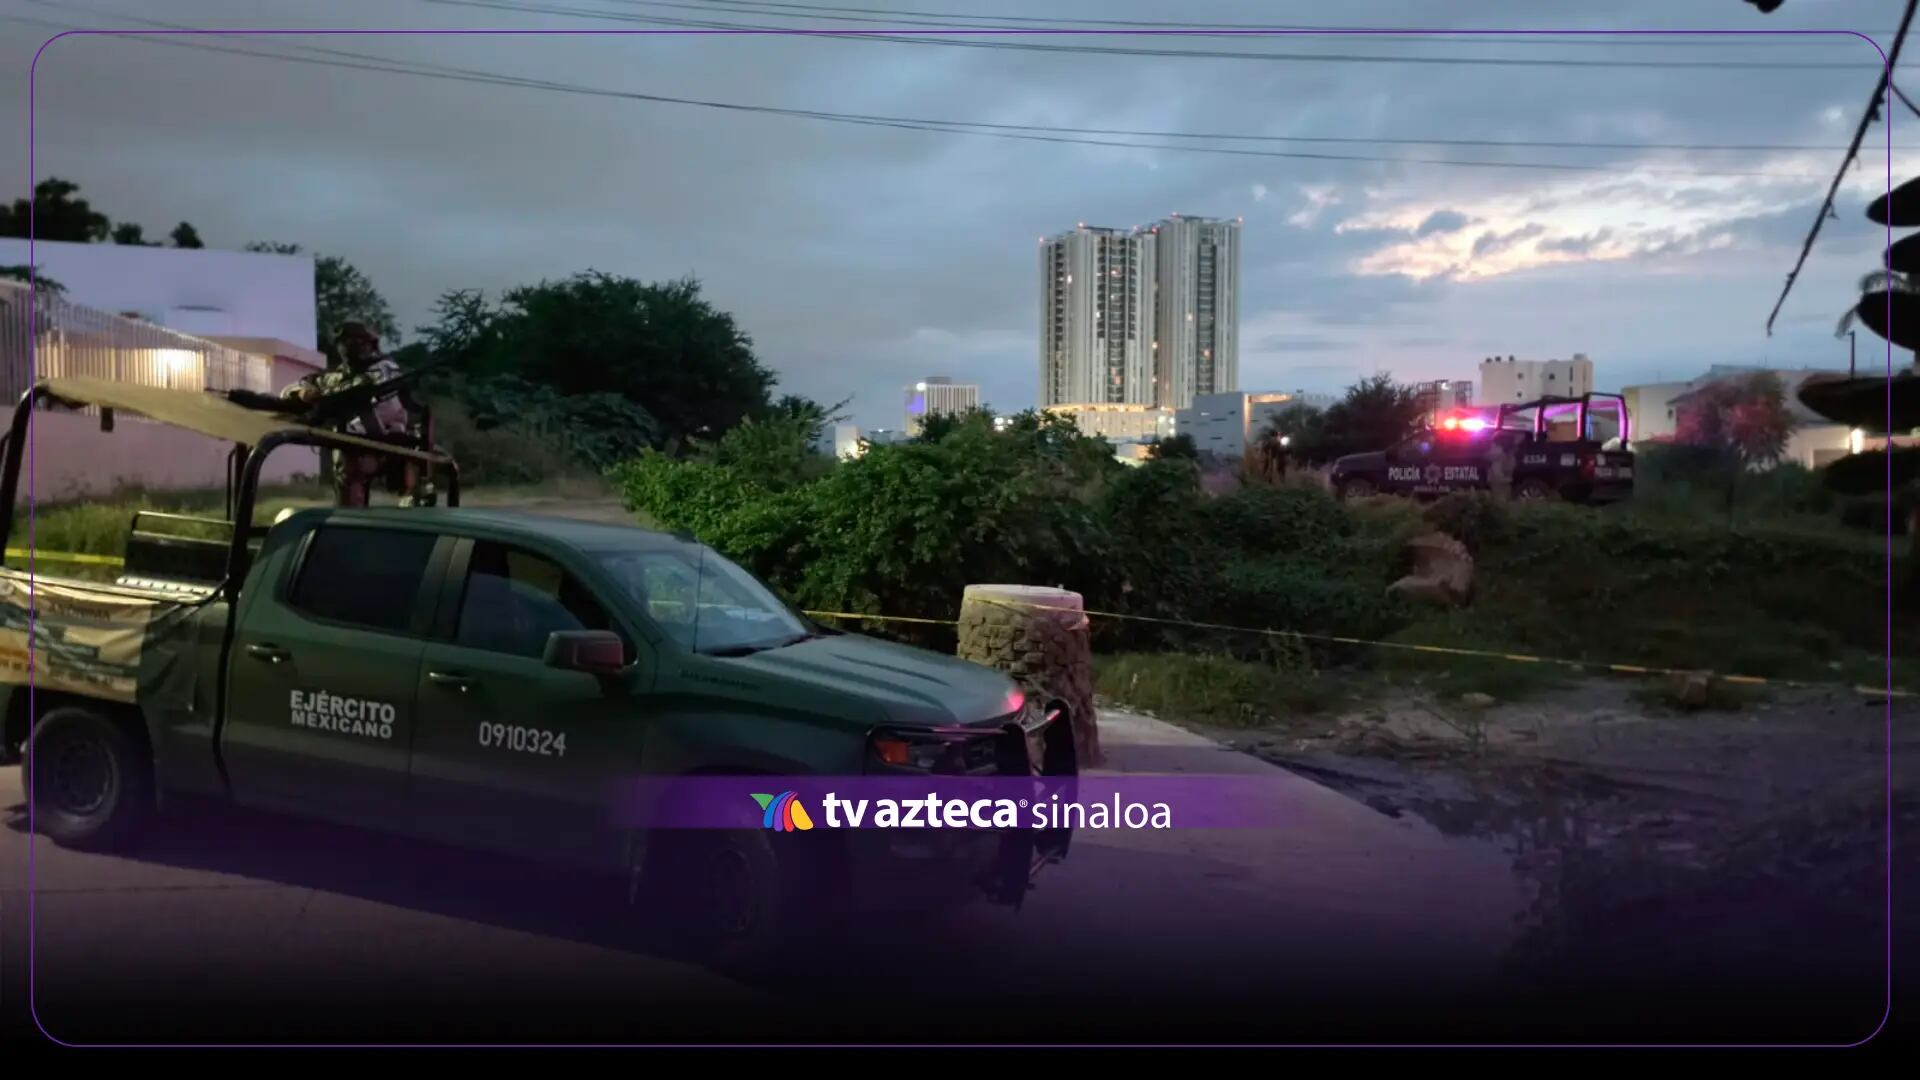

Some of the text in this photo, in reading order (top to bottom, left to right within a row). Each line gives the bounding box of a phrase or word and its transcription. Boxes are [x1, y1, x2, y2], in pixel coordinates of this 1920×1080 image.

[1444, 466, 1480, 481] ESTATAL
[290, 690, 395, 724] EJÉRCITO
[291, 710, 393, 739] MEXICANO
[479, 721, 566, 757] 0910324
